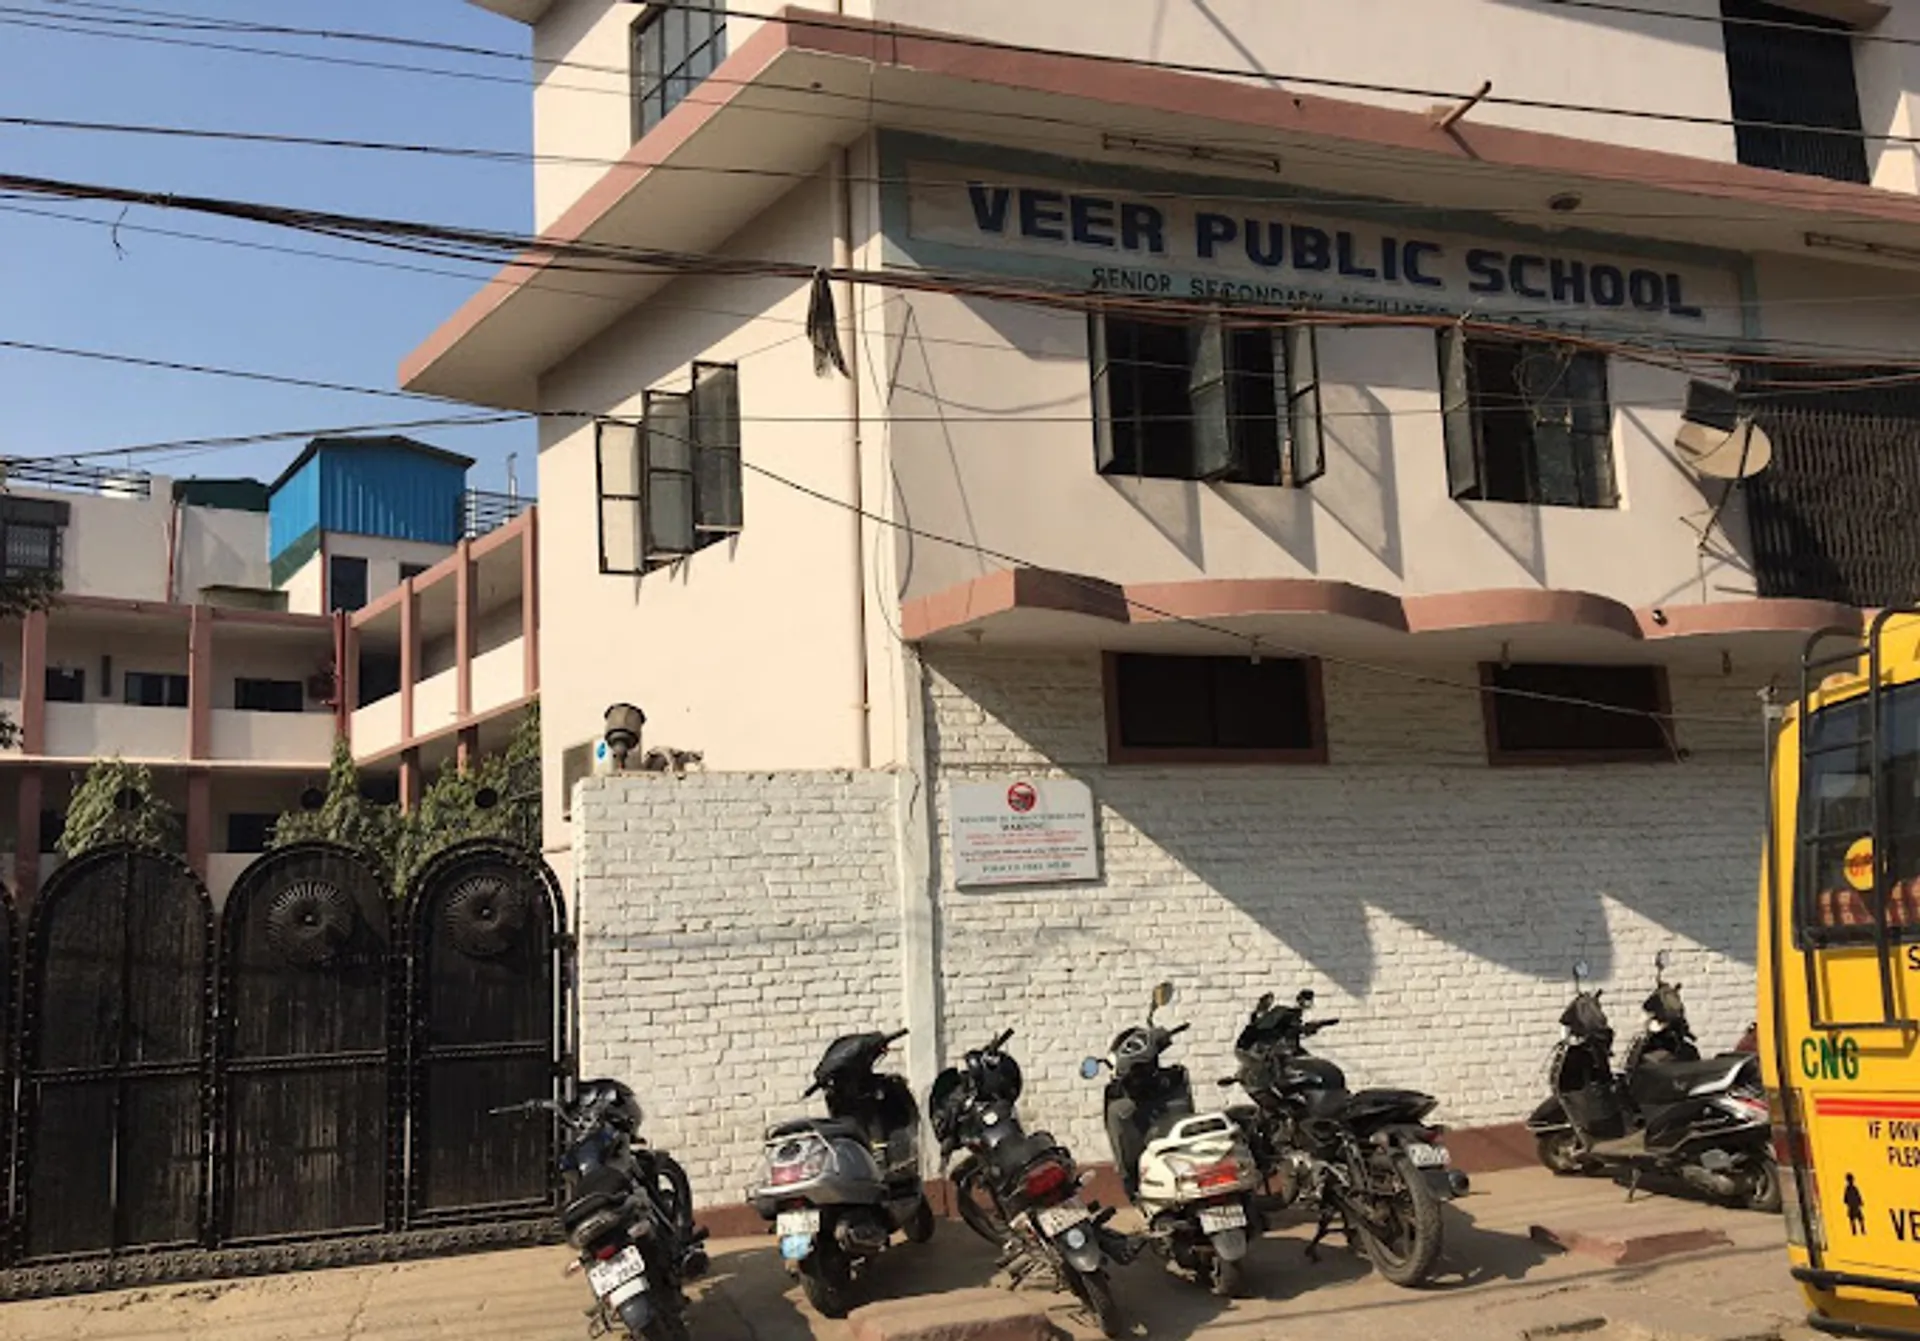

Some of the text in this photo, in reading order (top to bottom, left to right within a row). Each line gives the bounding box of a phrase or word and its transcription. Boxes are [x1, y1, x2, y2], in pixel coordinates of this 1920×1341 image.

[966, 181, 1703, 318] VEER PUBLIC SCHOOL
[1091, 267, 1172, 293] SENIOR
[1801, 1036, 1860, 1081] CNG
[1868, 1120, 1882, 1140] IF
